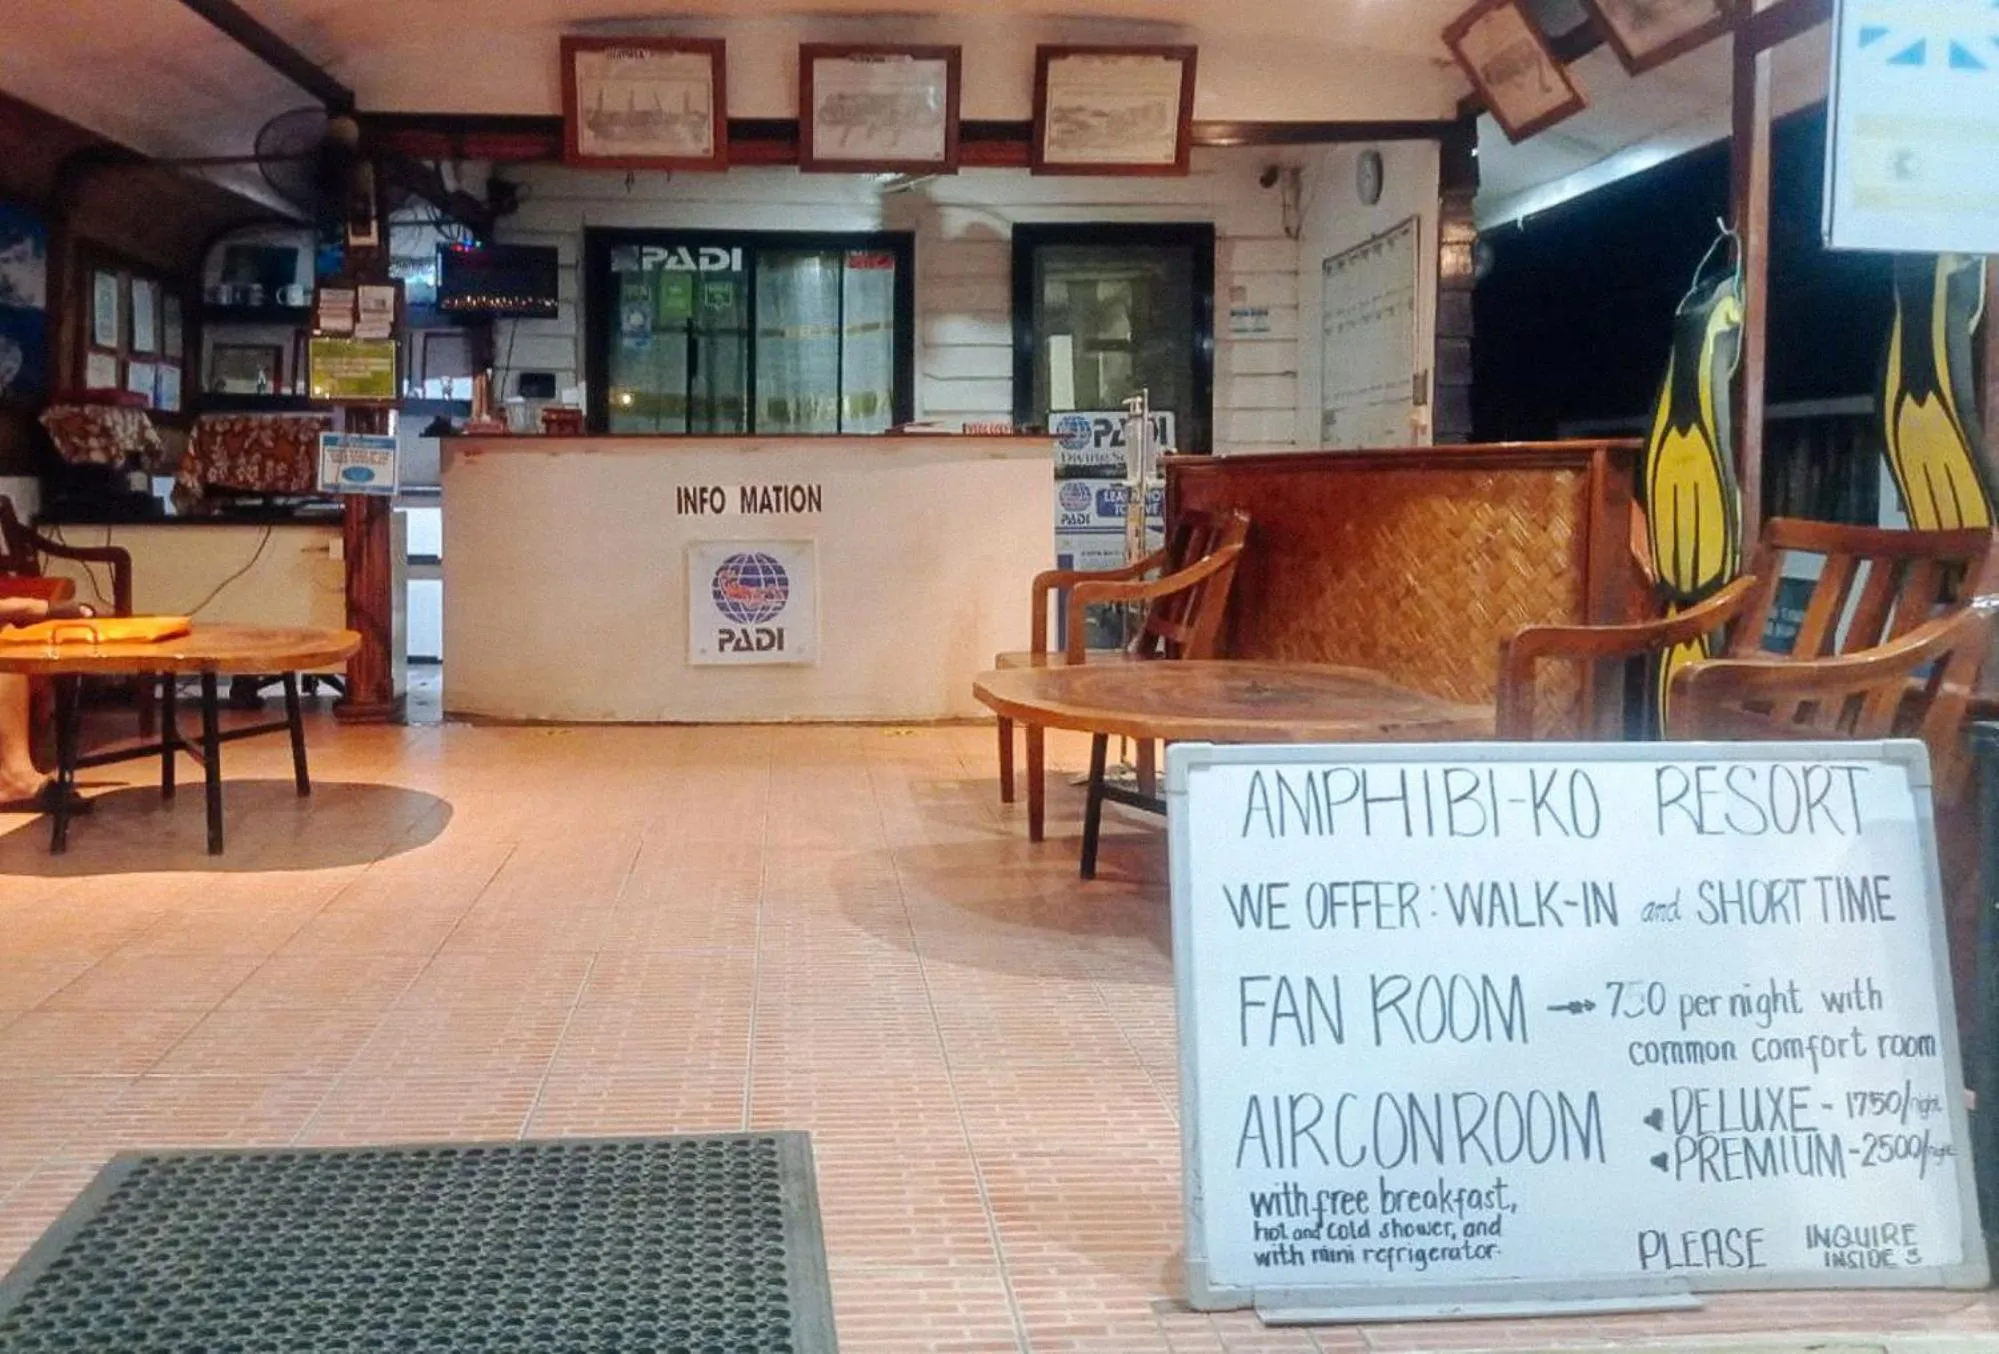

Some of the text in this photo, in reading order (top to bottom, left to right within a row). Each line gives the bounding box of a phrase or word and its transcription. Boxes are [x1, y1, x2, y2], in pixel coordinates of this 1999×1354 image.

[642, 245, 743, 272] PADI
[676, 484, 822, 515] INFO MATION
[1060, 513, 1091, 525] PADI
[718, 627, 784, 653] PADI
[1241, 763, 1869, 839] AMPHIBI-KO RESORT
[1222, 881, 1291, 931] WE
[1444, 879, 1620, 928] WALK-IN
[1640, 886, 1683, 924] and
[1696, 878, 1807, 926] SHORT
[1812, 874, 1897, 923] TIME
[1239, 972, 1529, 1048] FAN ROOM
[1679, 992, 1723, 1031] per
[1728, 975, 1804, 1029] night
[1820, 976, 1884, 1014] with
[1628, 1025, 1937, 1075] common comfort room
[1669, 1085, 1819, 1137] DELUXE
[1673, 1131, 1847, 1183] PREMIUM
[1249, 1175, 1518, 1229] with free breakfast,
[1292, 1222, 1322, 1241] and
[1326, 1218, 1372, 1241] cold
[1378, 1217, 1457, 1242] shower,
[1462, 1213, 1503, 1238] and
[1638, 1227, 1769, 1270] PLEASE
[1805, 1223, 1919, 1250] INQUIRE
[1253, 1242, 1306, 1268] with
[1310, 1243, 1356, 1265] mini
[1823, 1248, 1898, 1270] INSIDE
